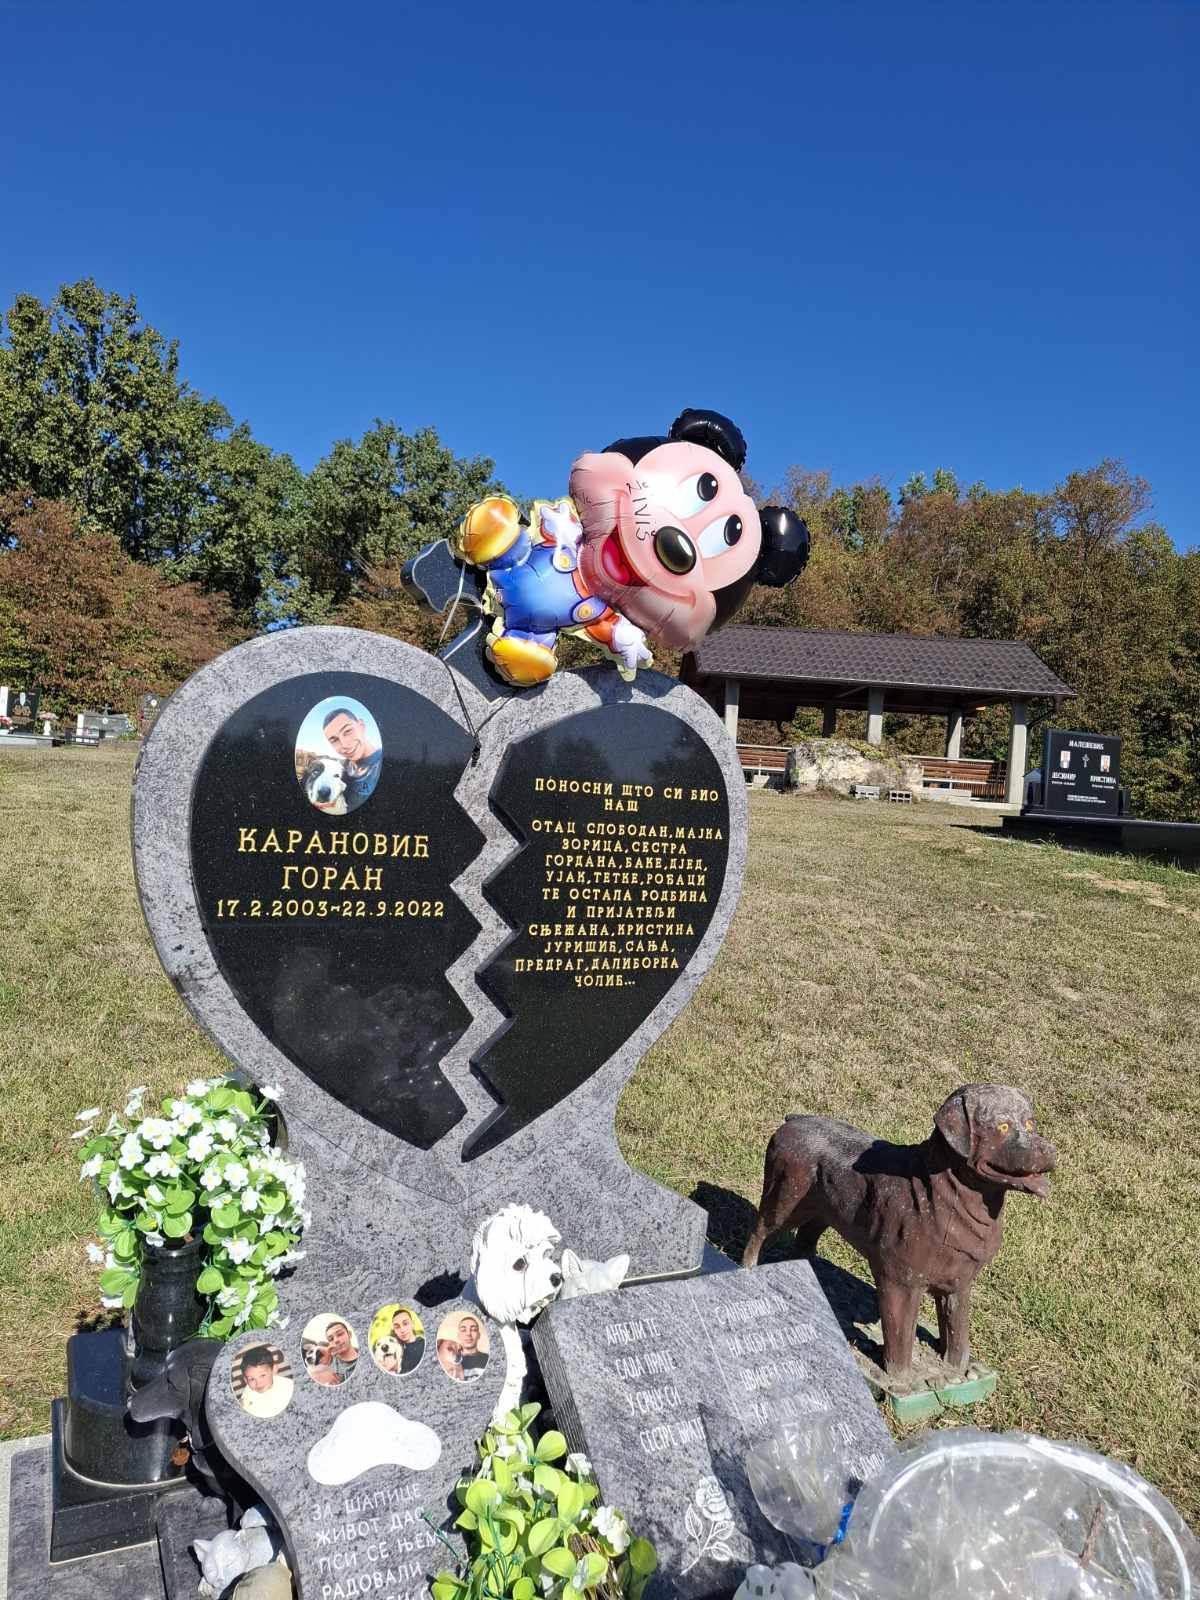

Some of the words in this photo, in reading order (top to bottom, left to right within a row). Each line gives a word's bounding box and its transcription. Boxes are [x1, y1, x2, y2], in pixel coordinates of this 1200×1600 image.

[534, 777, 613, 796] ПОНОСНИ
[621, 784, 654, 798] ШТО
[663, 787, 683, 800] СИ
[690, 788, 719, 802] БИО
[604, 798, 639, 813] НАШ
[531, 819, 576, 834] ОТАЦ
[237, 827, 429, 858] КАРАНОВИЋ
[281, 864, 384, 891] ГОРАН
[541, 887, 560, 900] ТЕ
[569, 888, 632, 902] ОСТАЛА
[641, 889, 708, 903] РОДБИНА
[566, 905, 577, 919] И
[586, 905, 676, 919] ПРИЈАТЕЉИ
[312, 1503, 334, 1521] ЗА
[344, 1483, 422, 1514] ШАПИЦЕ
[315, 1518, 380, 1549] ЖИВОТ
[319, 1551, 357, 1574] ПСИ
[367, 1541, 390, 1561] СЕ
[322, 1561, 423, 1600] РАДОВАЛИ
